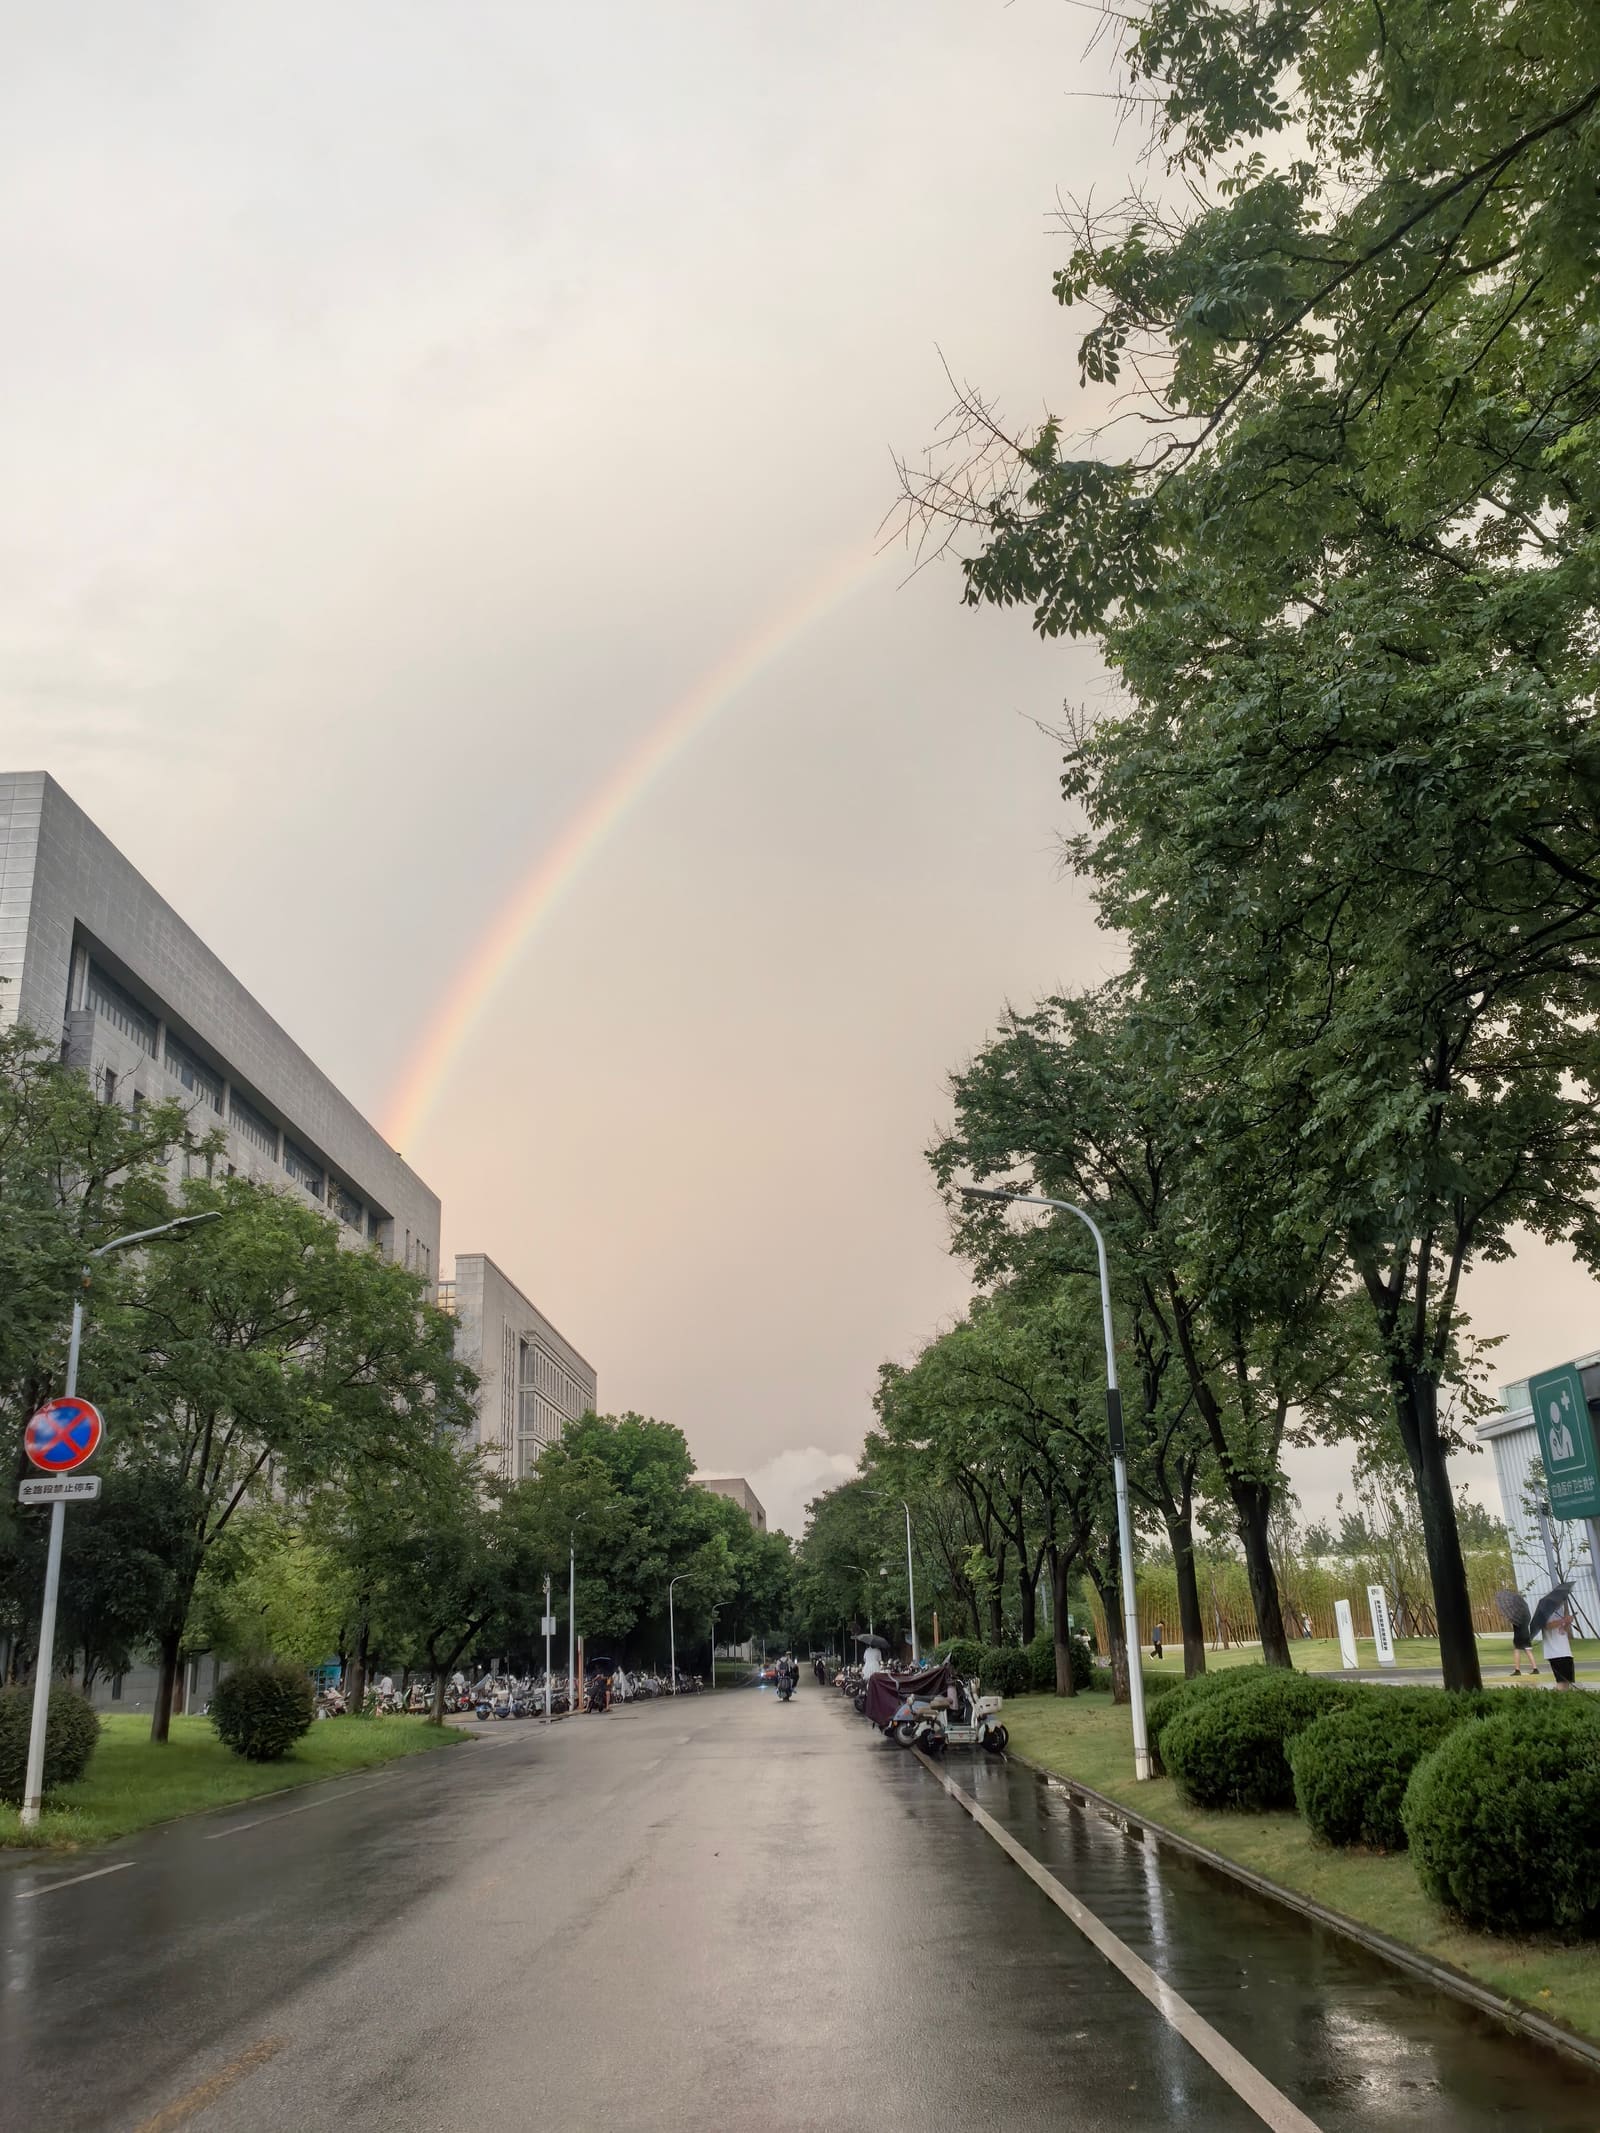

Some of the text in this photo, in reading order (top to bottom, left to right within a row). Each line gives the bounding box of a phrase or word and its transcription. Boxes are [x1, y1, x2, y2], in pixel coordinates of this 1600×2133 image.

[23, 1482, 95, 1496] 全路段禁止停车
